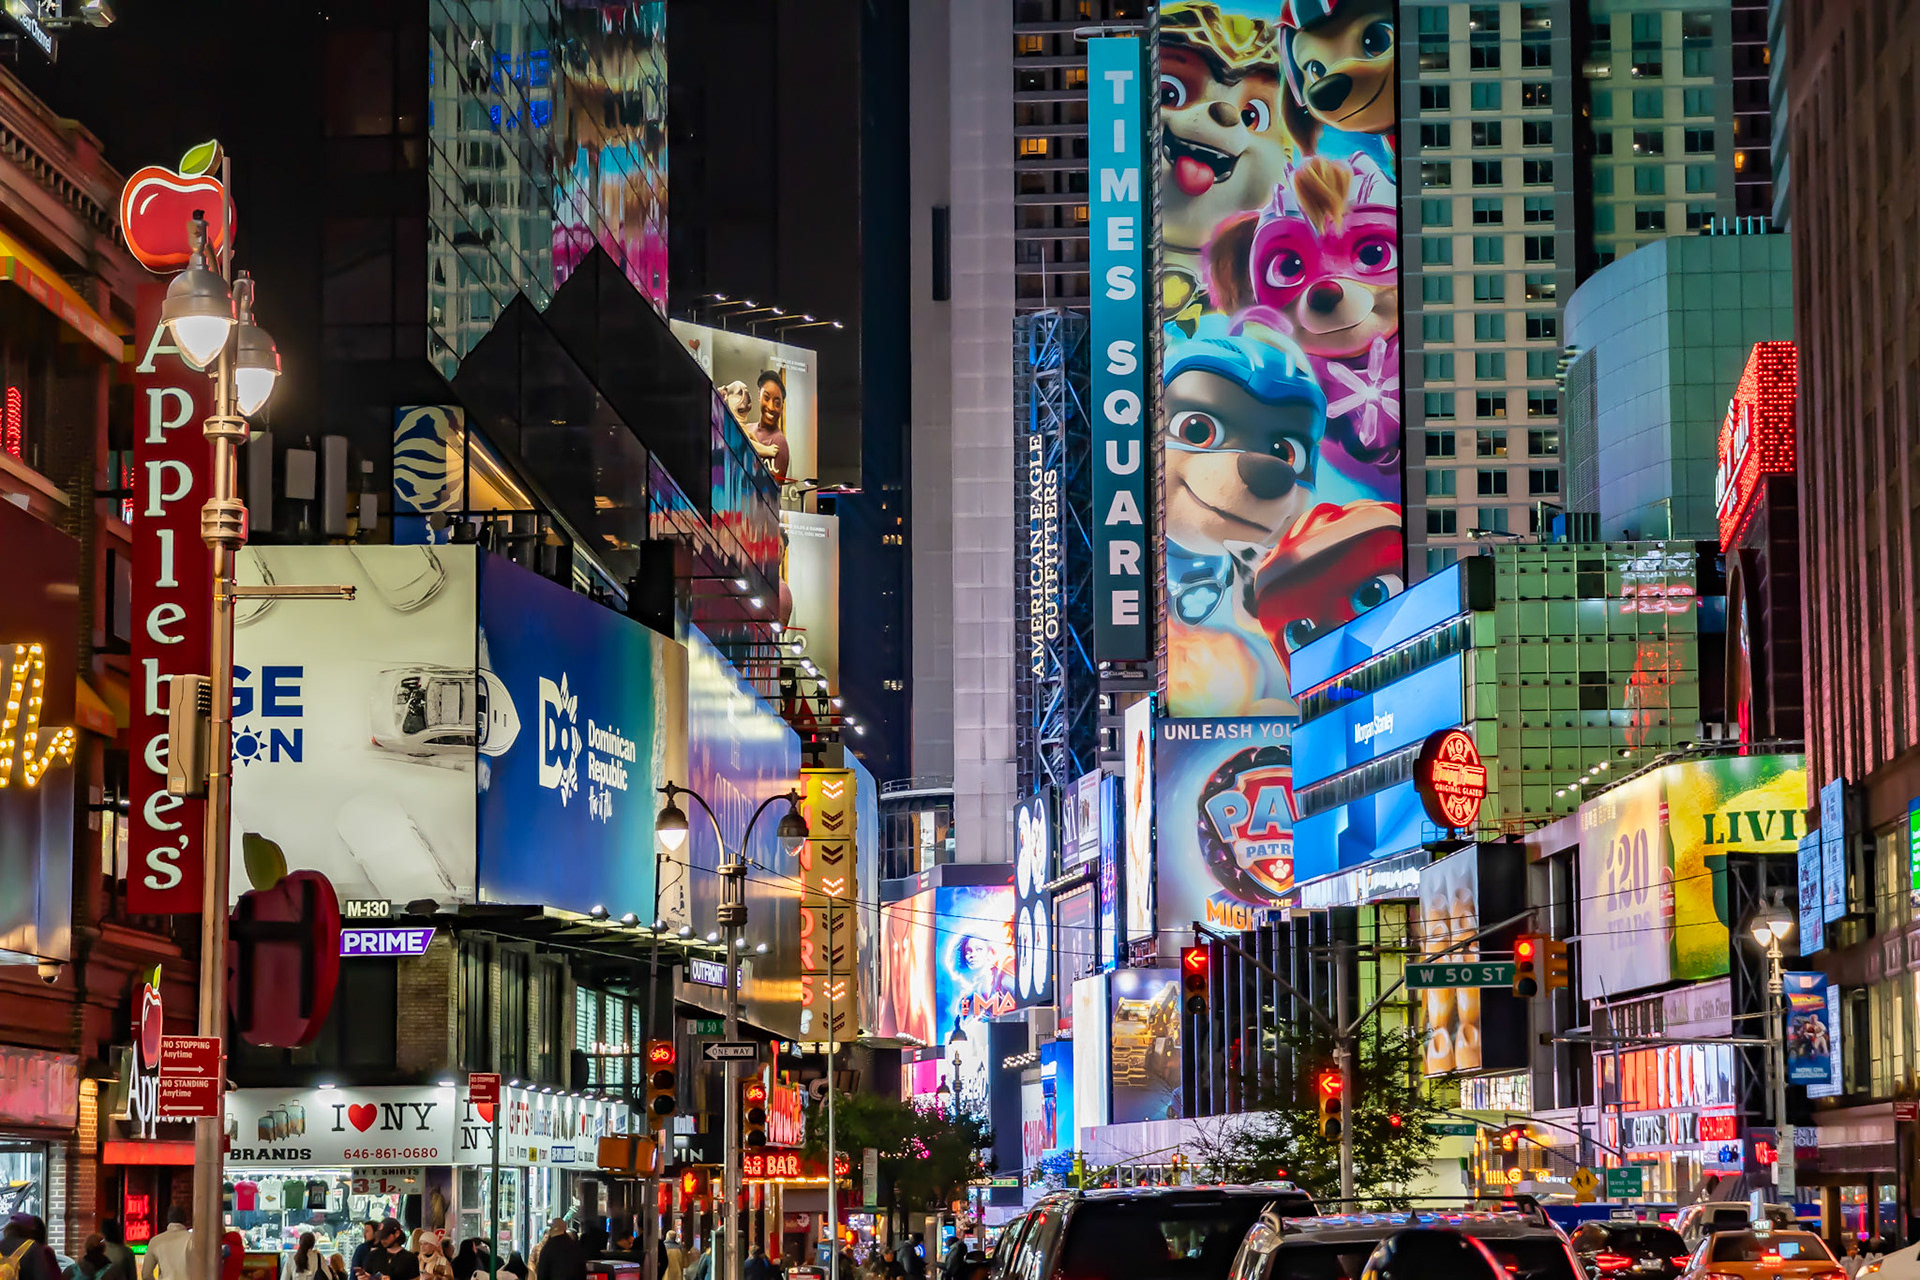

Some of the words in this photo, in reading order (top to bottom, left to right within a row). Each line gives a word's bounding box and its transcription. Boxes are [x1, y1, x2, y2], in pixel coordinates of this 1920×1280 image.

[1104, 70, 1139, 301] TIMES
[1030, 433, 1043, 521] EAGLE
[1103, 340, 1143, 625] SQUARE
[1044, 469, 1058, 639] OUTFITTERS
[1031, 529, 1044, 678] AMERICAN
[1164, 724, 1252, 740] UNLEASH
[1354, 720, 1374, 744] Morgan
[1374, 711, 1394, 735] Stanley
[588, 718, 636, 763] Dominican
[1447, 739, 1471, 758] HOT
[588, 751, 628, 791] Republic
[1434, 783, 1461, 794] ORIGINAL
[1462, 787, 1483, 797] GLAZED
[1206, 785, 1300, 844] PA
[1447, 796, 1472, 819] NOW
[1606, 828, 1649, 912] 120
[347, 901, 389, 917] M-130
[1269, 899, 1292, 907] THE
[344, 933, 425, 952] PRIME
[692, 961, 724, 984] OUTFRONT
[1420, 968, 1434, 983] W
[1446, 968, 1472, 983] 50
[1482, 967, 1505, 981] ST
[697, 1022, 704, 1033] W
[708, 1022, 717, 1032] 50
[163, 1040, 174, 1048] NO
[175, 1041, 210, 1049] STOPPING
[712, 1047, 728, 1055] ONE
[733, 1047, 750, 1055] WAY
[163, 1050, 193, 1059] Anytime
[162, 1089, 192, 1098] Anytime
[174, 1080, 209, 1088] STANDING
[332, 1103, 345, 1132] I
[380, 1102, 437, 1131] NY
[1632, 1114, 1661, 1146] GIFTS
[230, 1148, 312, 1161] BRANDS
[344, 1147, 438, 1159] 646-861-0680
[381, 1168, 420, 1176] SHIRTS
[766, 1155, 798, 1175] BAR
